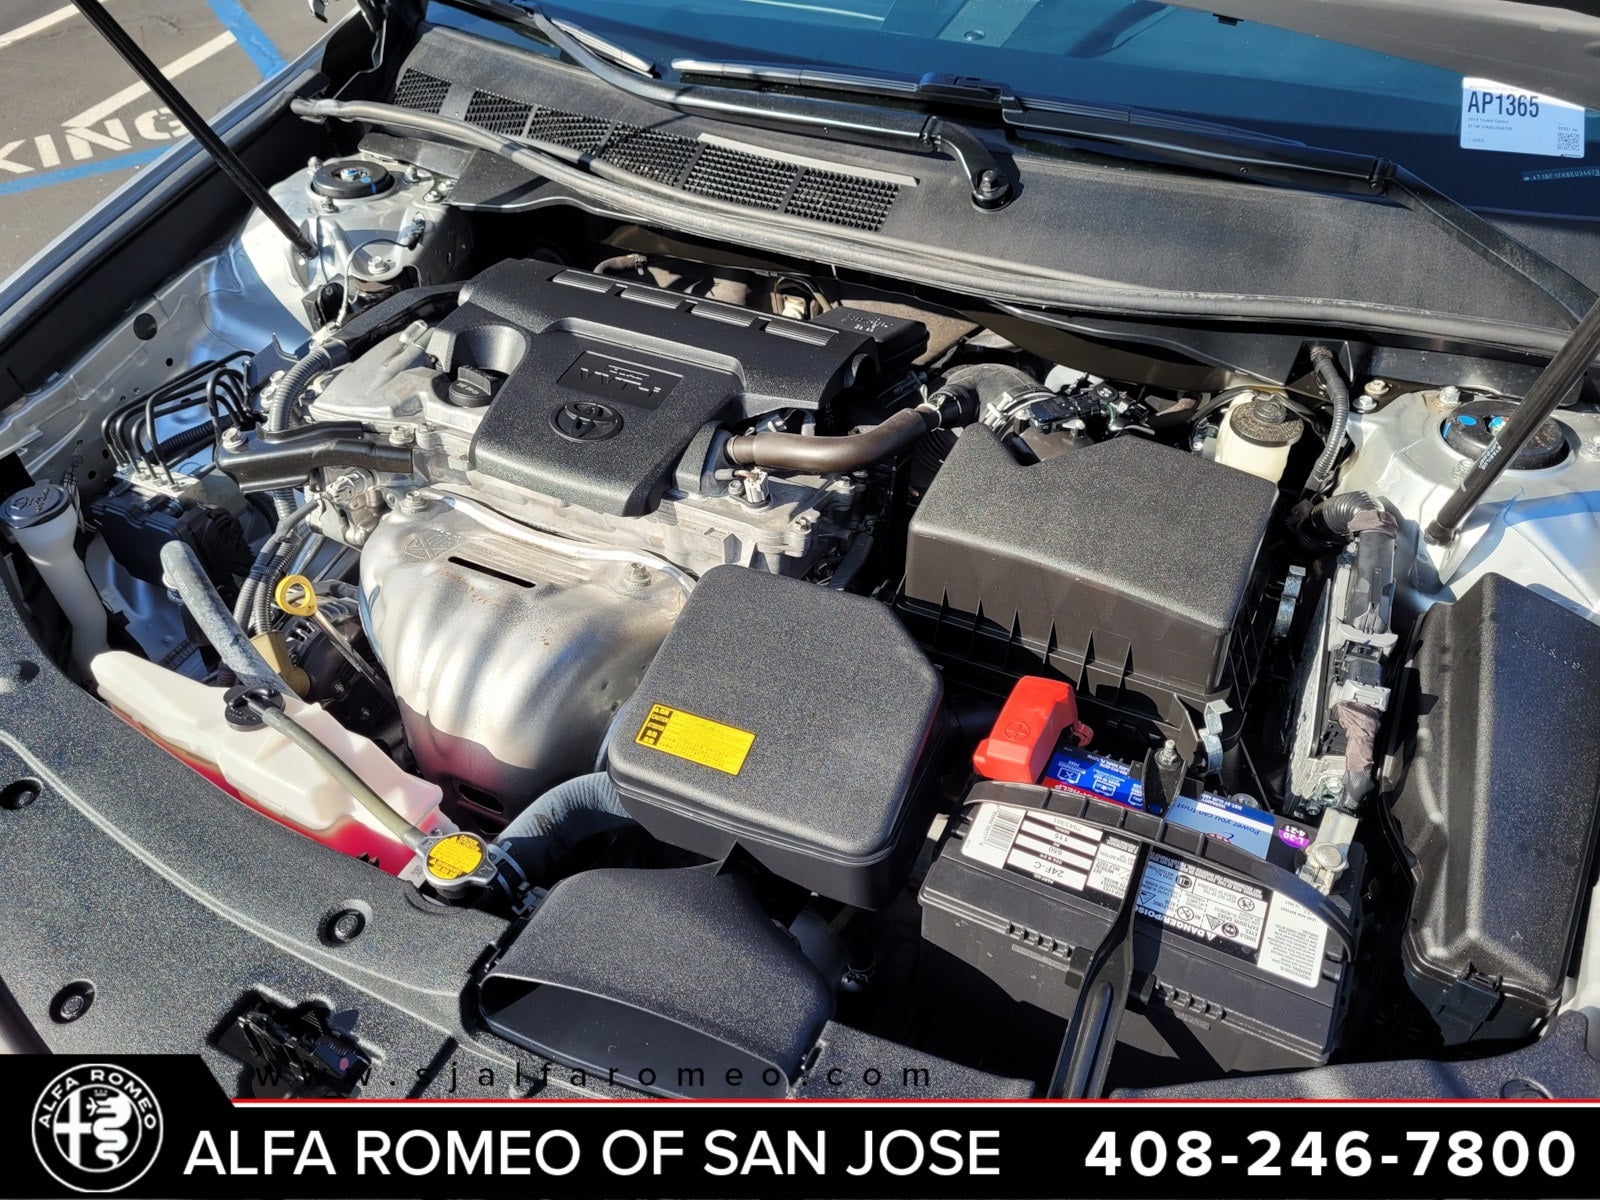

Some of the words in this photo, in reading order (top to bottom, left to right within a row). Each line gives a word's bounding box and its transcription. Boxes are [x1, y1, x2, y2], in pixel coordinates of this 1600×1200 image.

[1467, 90, 1540, 119] AP1365
[1053, 832, 1068, 841] 115
[1284, 824, 1306, 837] 4-21
[1281, 831, 1304, 845] L-20
[1048, 845, 1062, 855] 650
[1032, 860, 1064, 878] 24F-C
